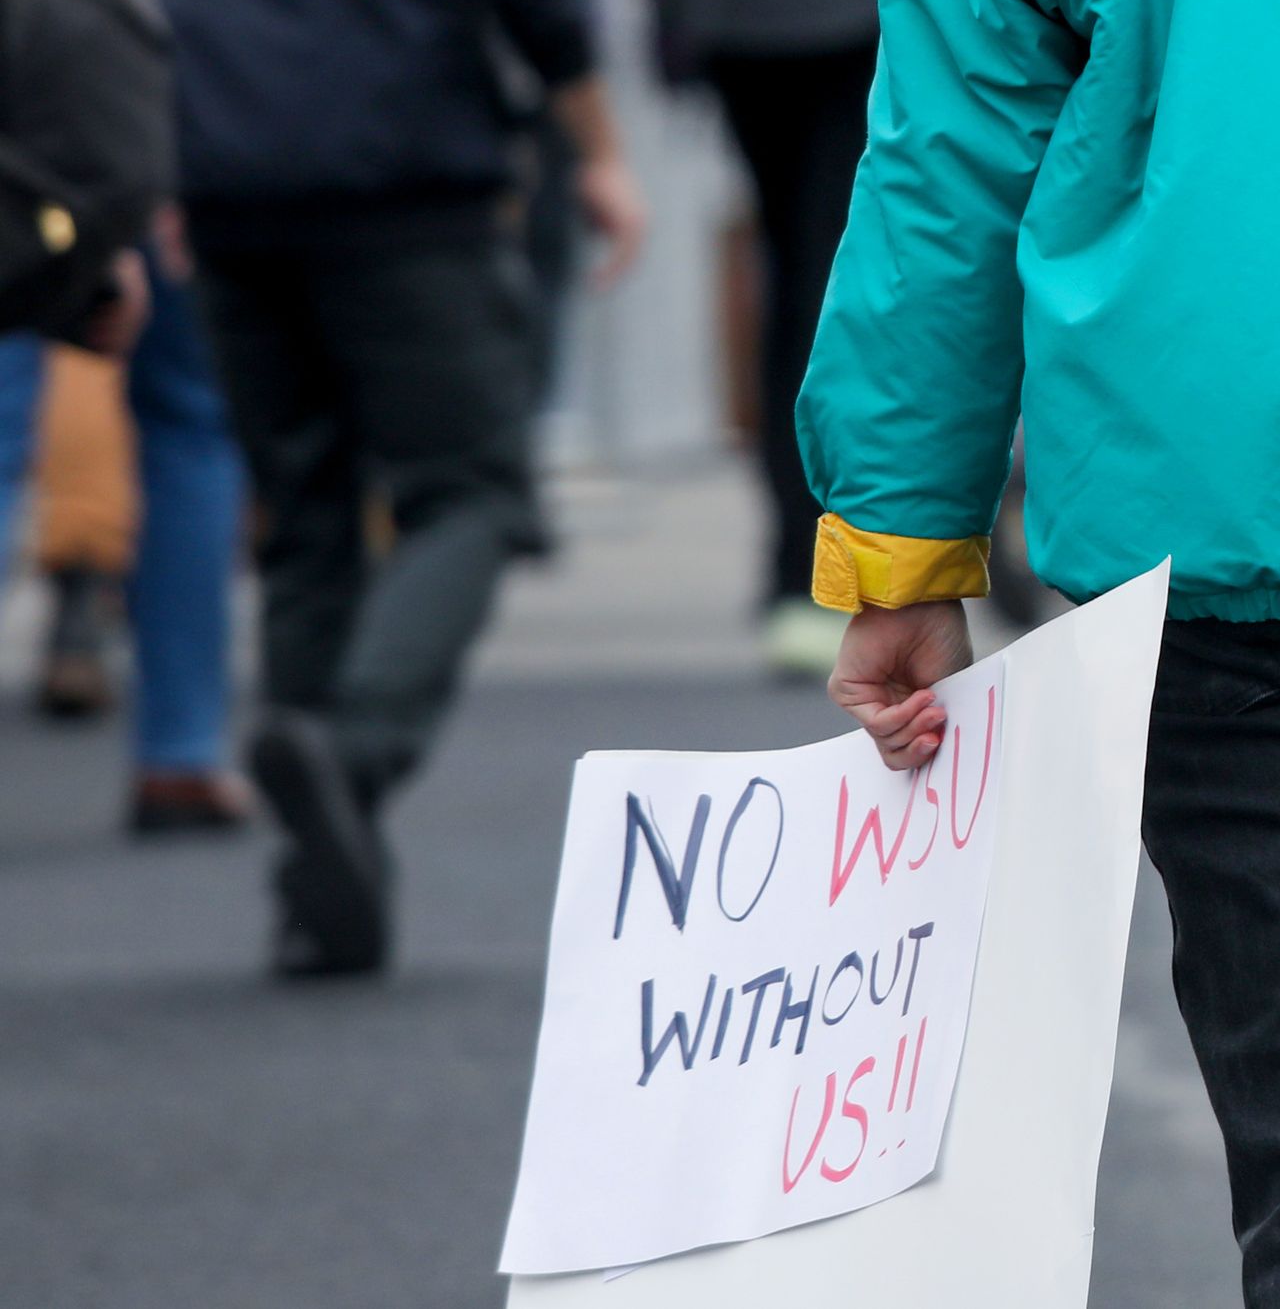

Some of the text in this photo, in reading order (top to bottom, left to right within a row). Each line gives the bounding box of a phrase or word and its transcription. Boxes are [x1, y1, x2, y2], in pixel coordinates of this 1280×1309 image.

[612, 685, 995, 940] NO WSU
[637, 922, 935, 1087] WITHOUT
[781, 1017, 928, 1194] US!!
